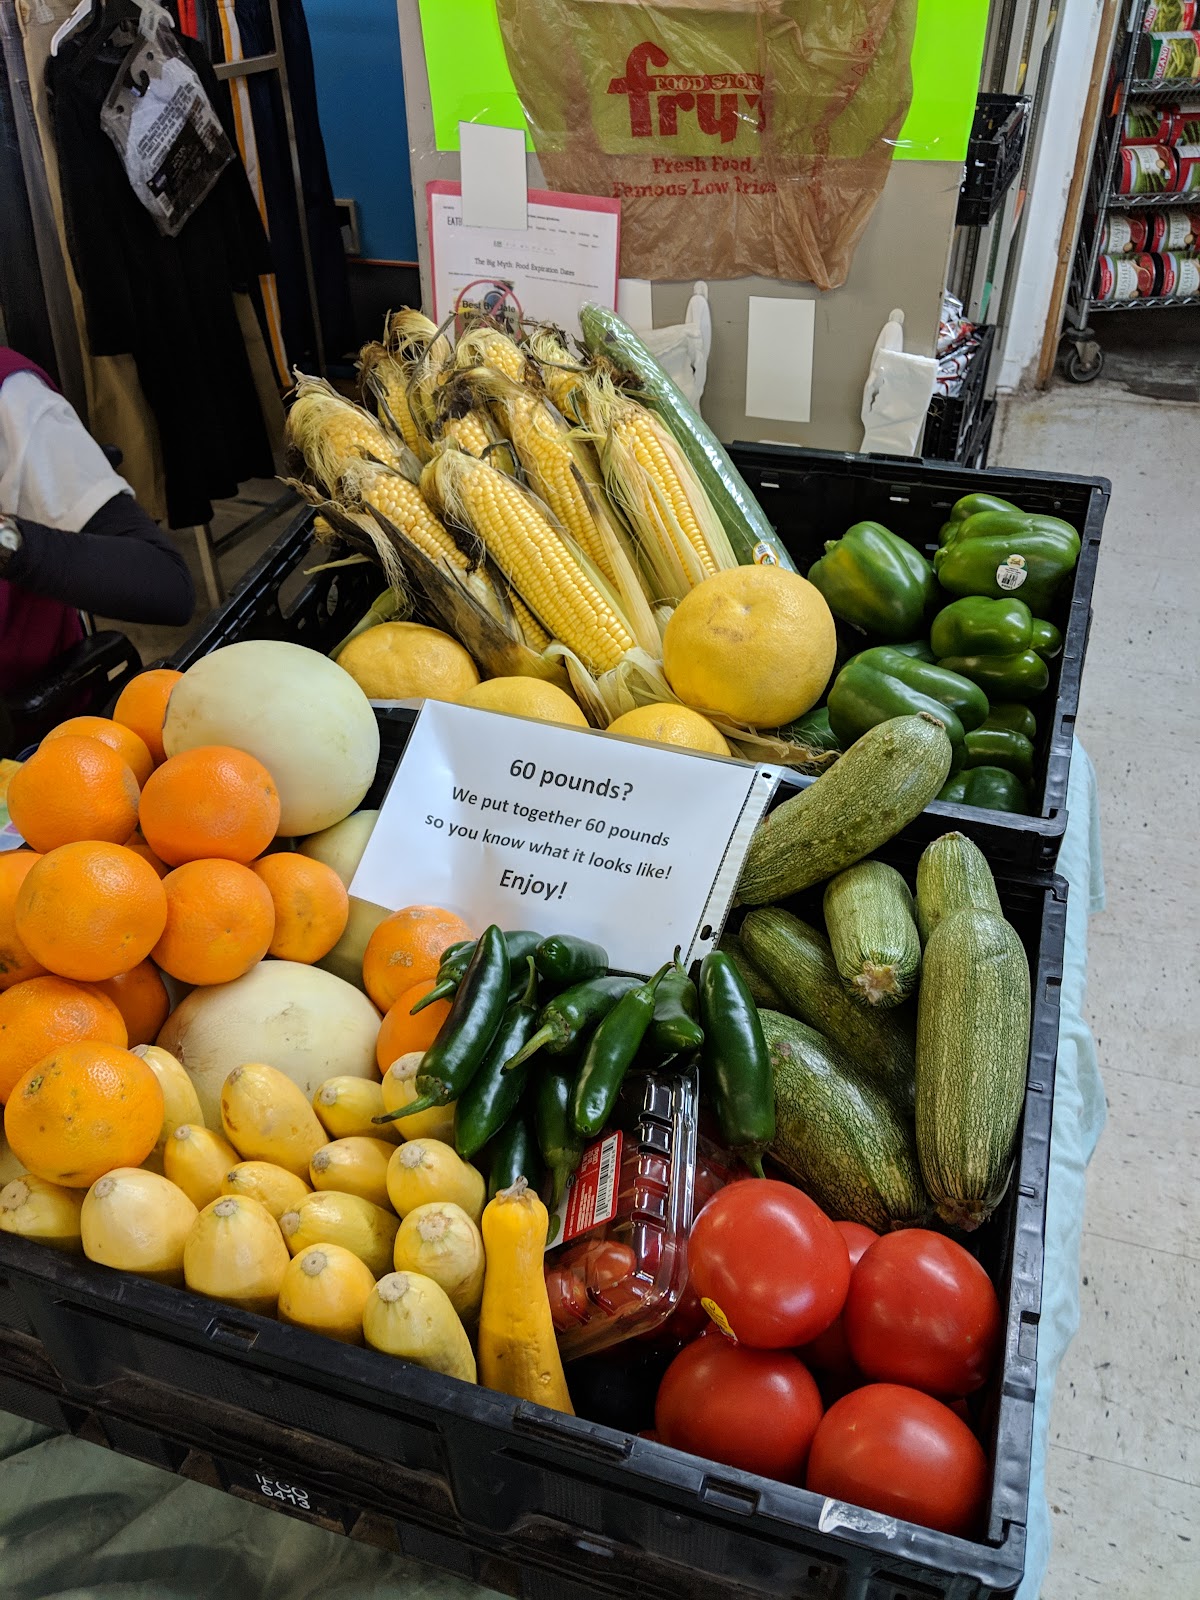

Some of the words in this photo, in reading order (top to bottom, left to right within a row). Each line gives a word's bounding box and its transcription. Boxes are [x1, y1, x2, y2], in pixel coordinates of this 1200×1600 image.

[655, 77, 705, 91] FOOD
[711, 75, 759, 90] STOR
[652, 157, 707, 174] Fresh
[612, 181, 688, 198] Famous
[692, 178, 730, 195] Low
[474, 257, 485, 265] The
[486, 259, 495, 268] Big
[516, 262, 530, 271] Food
[531, 264, 558, 275] Expiration
[560, 268, 575, 277] Dates
[462, 300, 481, 310] Best
[510, 759, 536, 780] 60
[539, 768, 634, 801] pounds?
[452, 786, 478, 805] We
[481, 795, 510, 813] put
[513, 802, 582, 829] together
[585, 818, 606, 834] 60
[607, 823, 671, 847] pounds
[424, 814, 444, 829] so
[448, 822, 479, 840] you
[482, 828, 526, 850] know
[528, 840, 570, 860] what
[572, 848, 586, 863] it
[588, 852, 633, 874] looks
[635, 861, 673, 880] like!
[499, 869, 568, 901] Enjoy!
[261, 1485, 310, 1510] 6413
